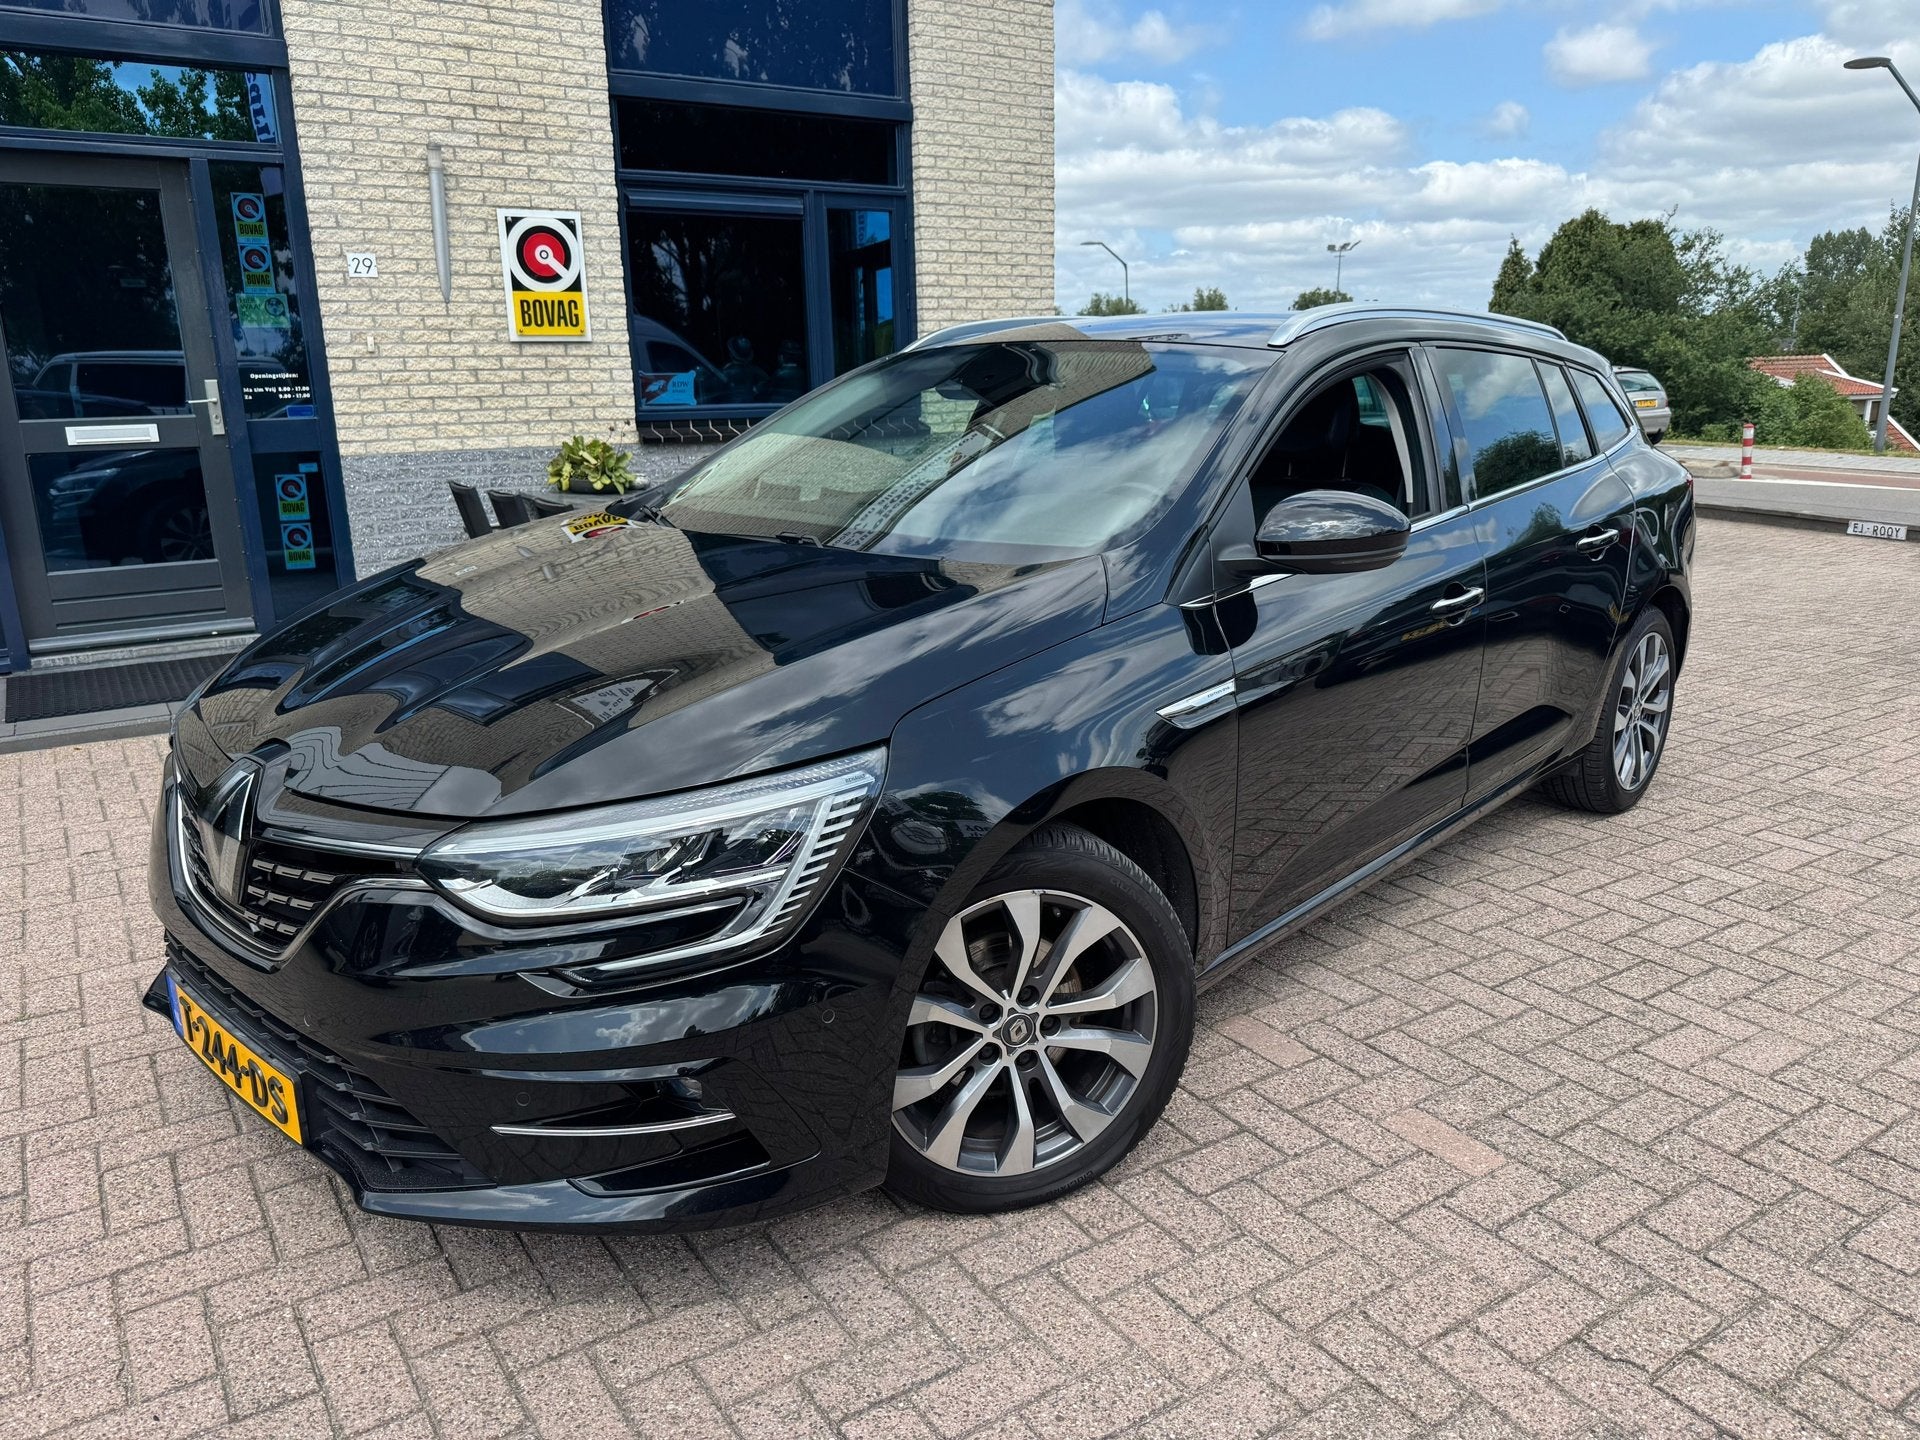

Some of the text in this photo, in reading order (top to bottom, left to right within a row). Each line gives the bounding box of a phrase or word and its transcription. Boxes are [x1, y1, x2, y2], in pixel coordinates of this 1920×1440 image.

[239, 223, 264, 236] BOVAG
[352, 257, 373, 274] 29
[246, 273, 271, 286] BOVAG
[519, 299, 580, 328] BOVAG
[249, 372, 299, 380] Openingstijden:
[282, 502, 305, 513] BOVAG
[288, 550, 311, 562] BOVAG
[179, 996, 289, 1125] T-244-DS
